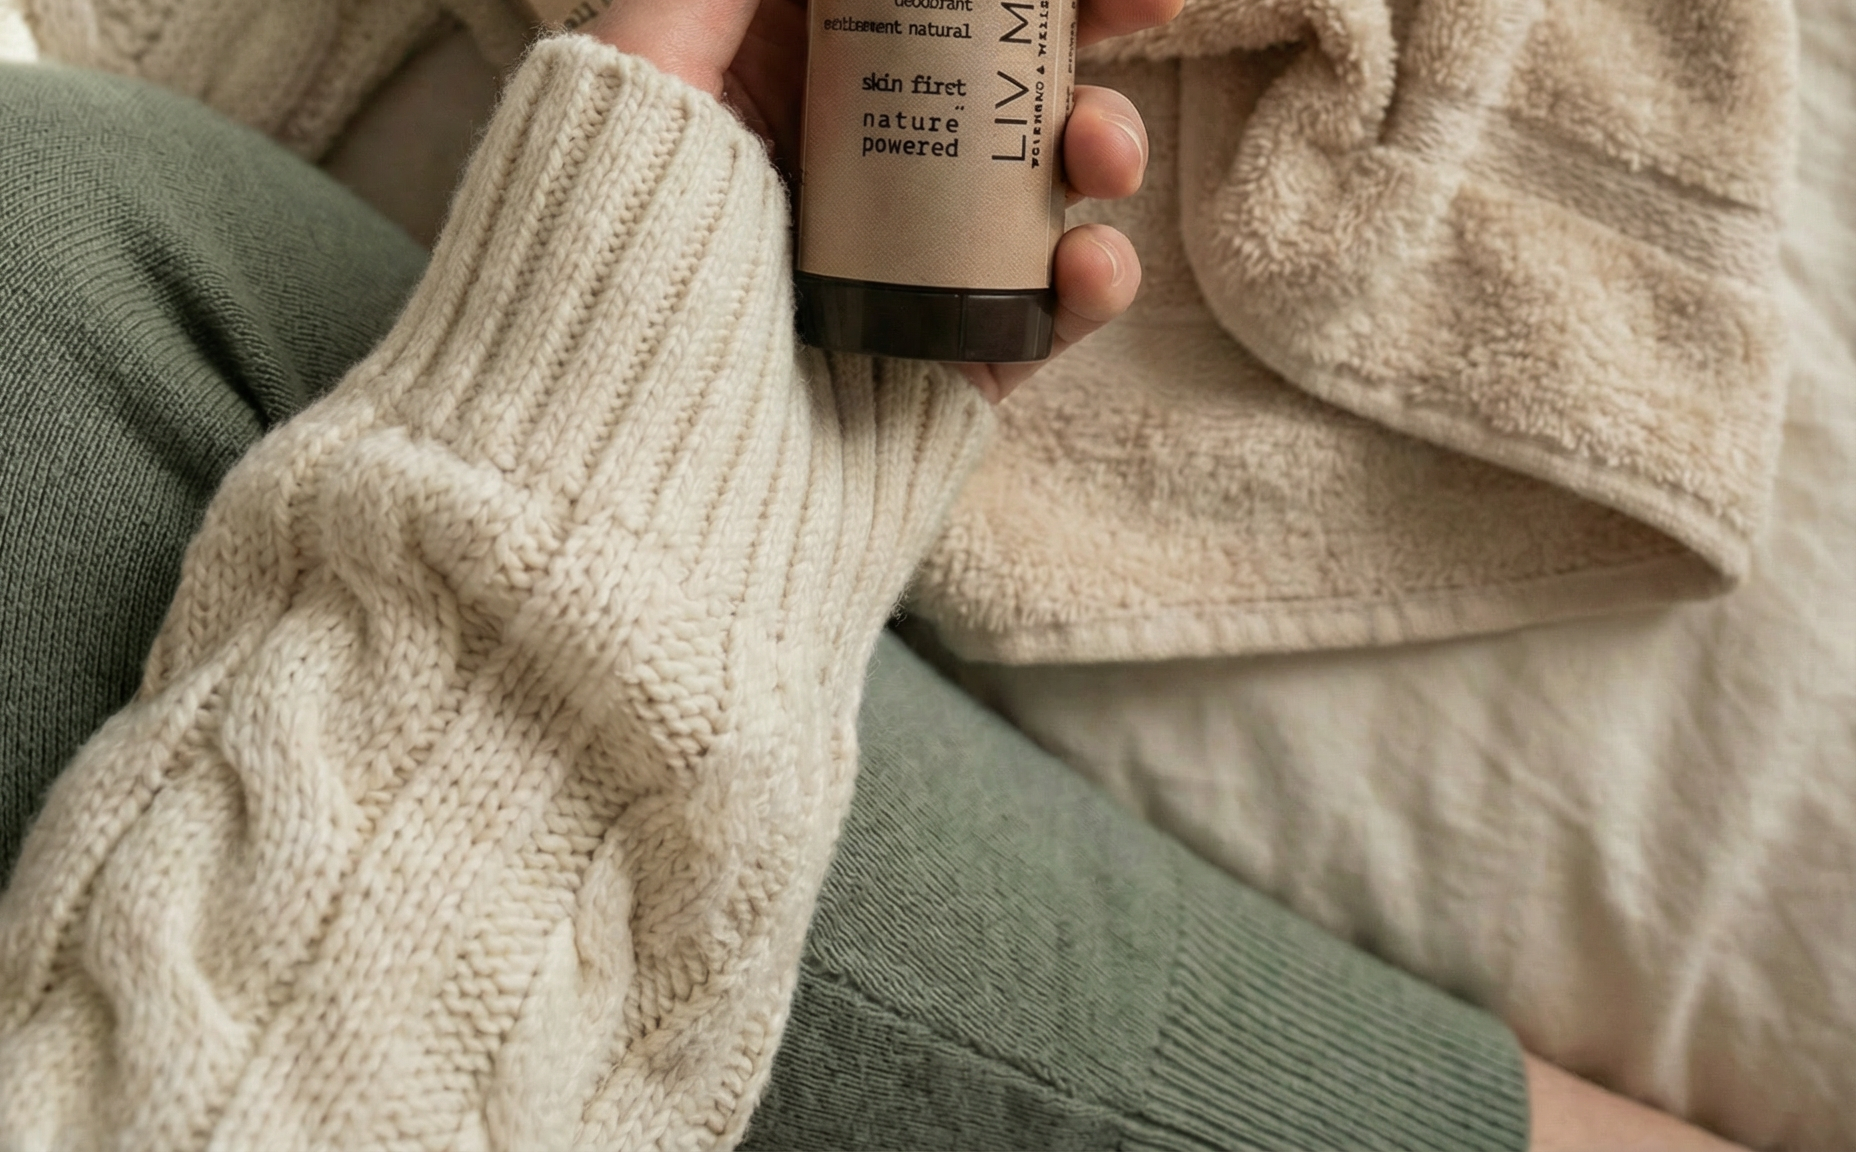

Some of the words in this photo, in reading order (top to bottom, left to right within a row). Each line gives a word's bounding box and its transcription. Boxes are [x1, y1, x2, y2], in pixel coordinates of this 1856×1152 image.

[908, 22, 973, 39] natural
[862, 72, 903, 93] skin
[863, 111, 959, 133] nature
[991, 70, 1029, 161] LIV
[862, 136, 959, 158] powered
